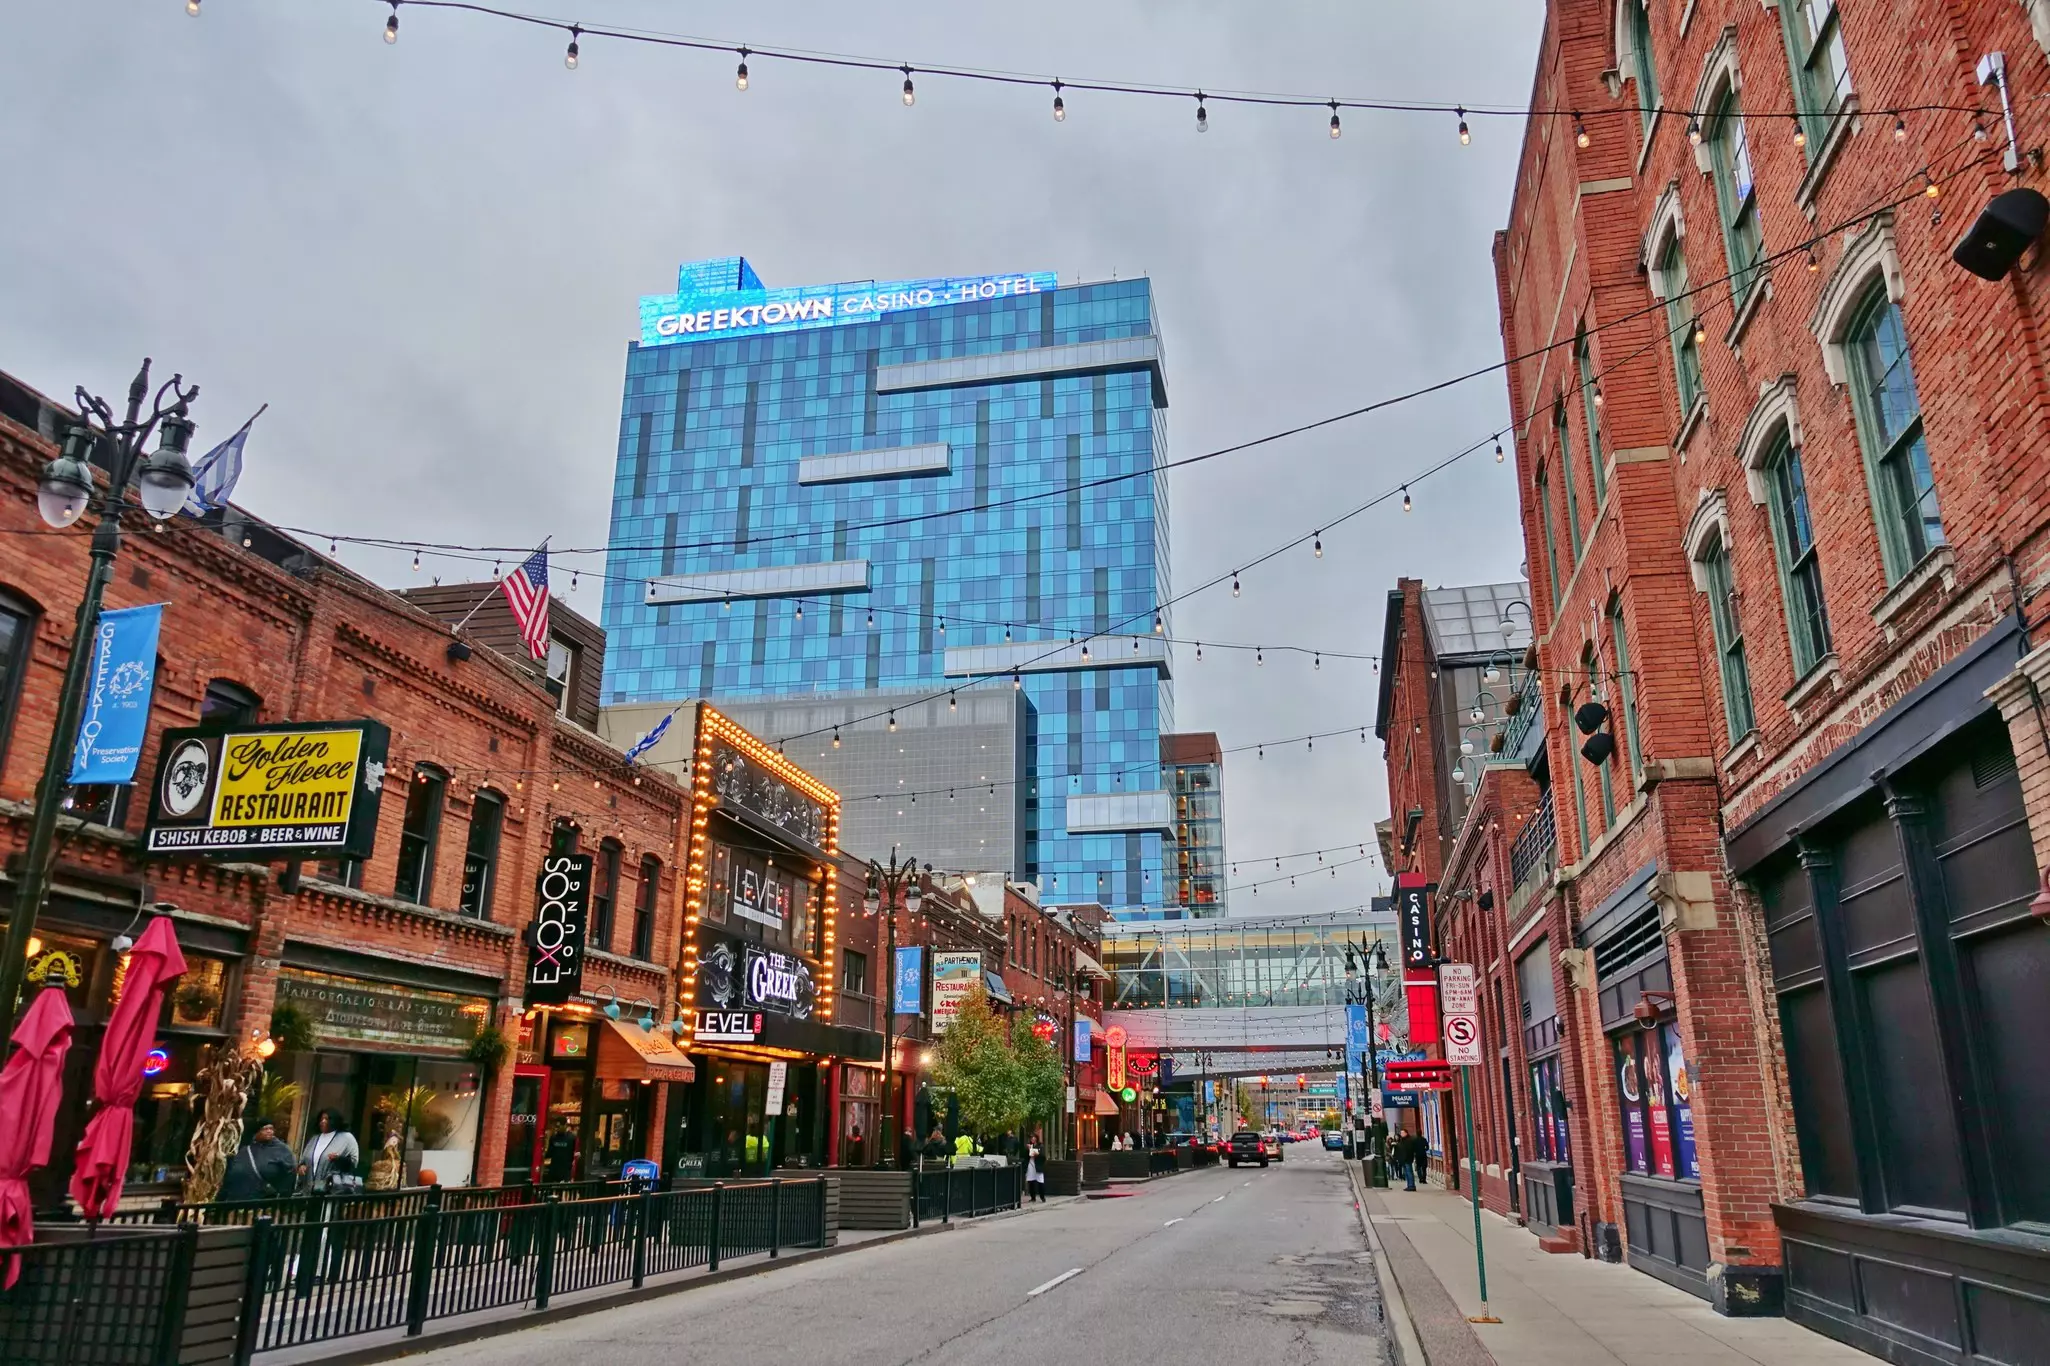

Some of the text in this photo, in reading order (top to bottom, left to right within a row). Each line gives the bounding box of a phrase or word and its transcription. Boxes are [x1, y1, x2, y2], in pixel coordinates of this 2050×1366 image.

[656, 277, 1041, 336] GREEKTOWN CASINO HOTEL
[92, 745, 139, 756] Preservation
[100, 754, 129, 764] Society
[228, 736, 330, 782] Golden
[265, 759, 354, 791] Fleece
[219, 790, 348, 821] RESTAURANT
[158, 829, 199, 846] SHISH
[203, 828, 247, 844] KEBOB
[260, 827, 293, 843] BEER
[303, 826, 340, 841] WINE
[734, 864, 782, 918] LEVEL
[532, 857, 572, 984] EXODOS
[560, 863, 582, 975] LOUNGE
[1409, 893, 1424, 961] CASINO
[769, 952, 786, 970] THE
[944, 956, 979, 965] PARTHENON
[752, 956, 798, 1002] GREEK
[935, 981, 973, 993] RESTAURA
[695, 1012, 754, 1033] LEVEL
[753, 1013, 763, 1034] TWO
[1450, 1054, 1478, 1062] STANDING
[1458, 1046, 1470, 1054] NO
[678, 1157, 703, 1169] GREEK
